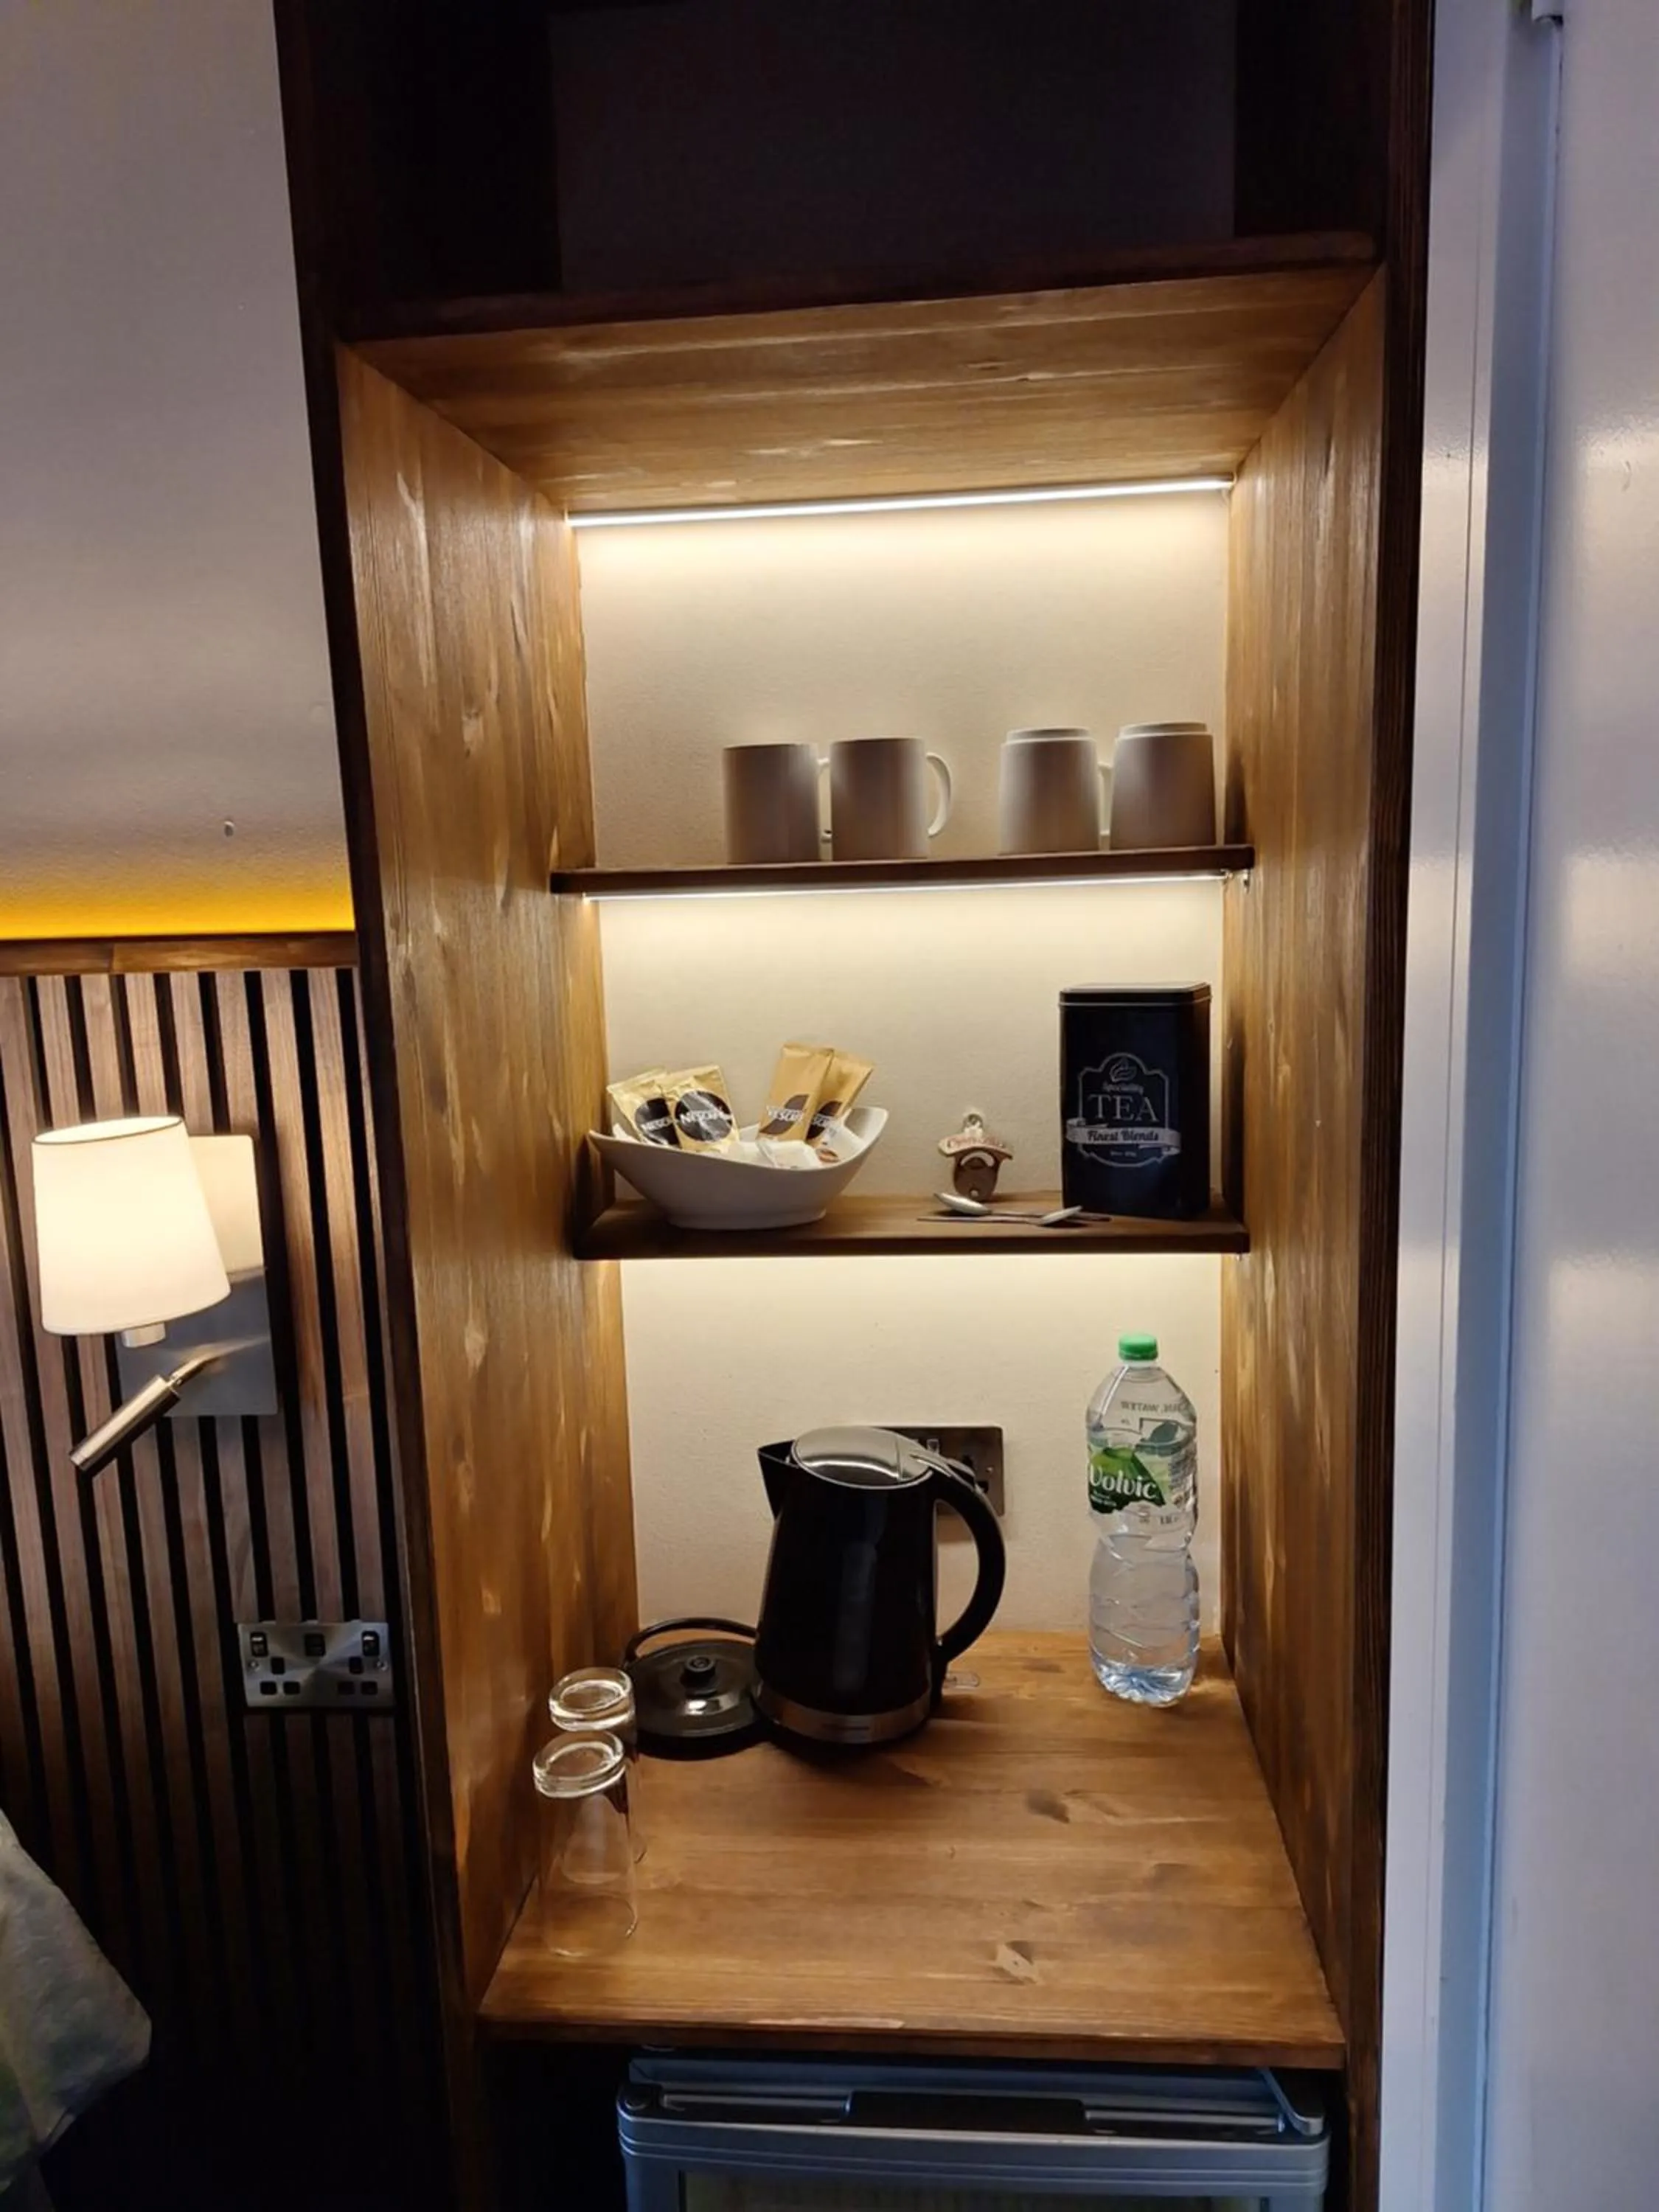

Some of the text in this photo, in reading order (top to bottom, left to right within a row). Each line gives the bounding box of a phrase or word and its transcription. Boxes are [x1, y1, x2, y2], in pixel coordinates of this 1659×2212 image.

[1087, 1094, 1160, 1122] TEA
[1120, 1130, 1159, 1142] Blends
[1089, 1464, 1157, 1500] Volvic
